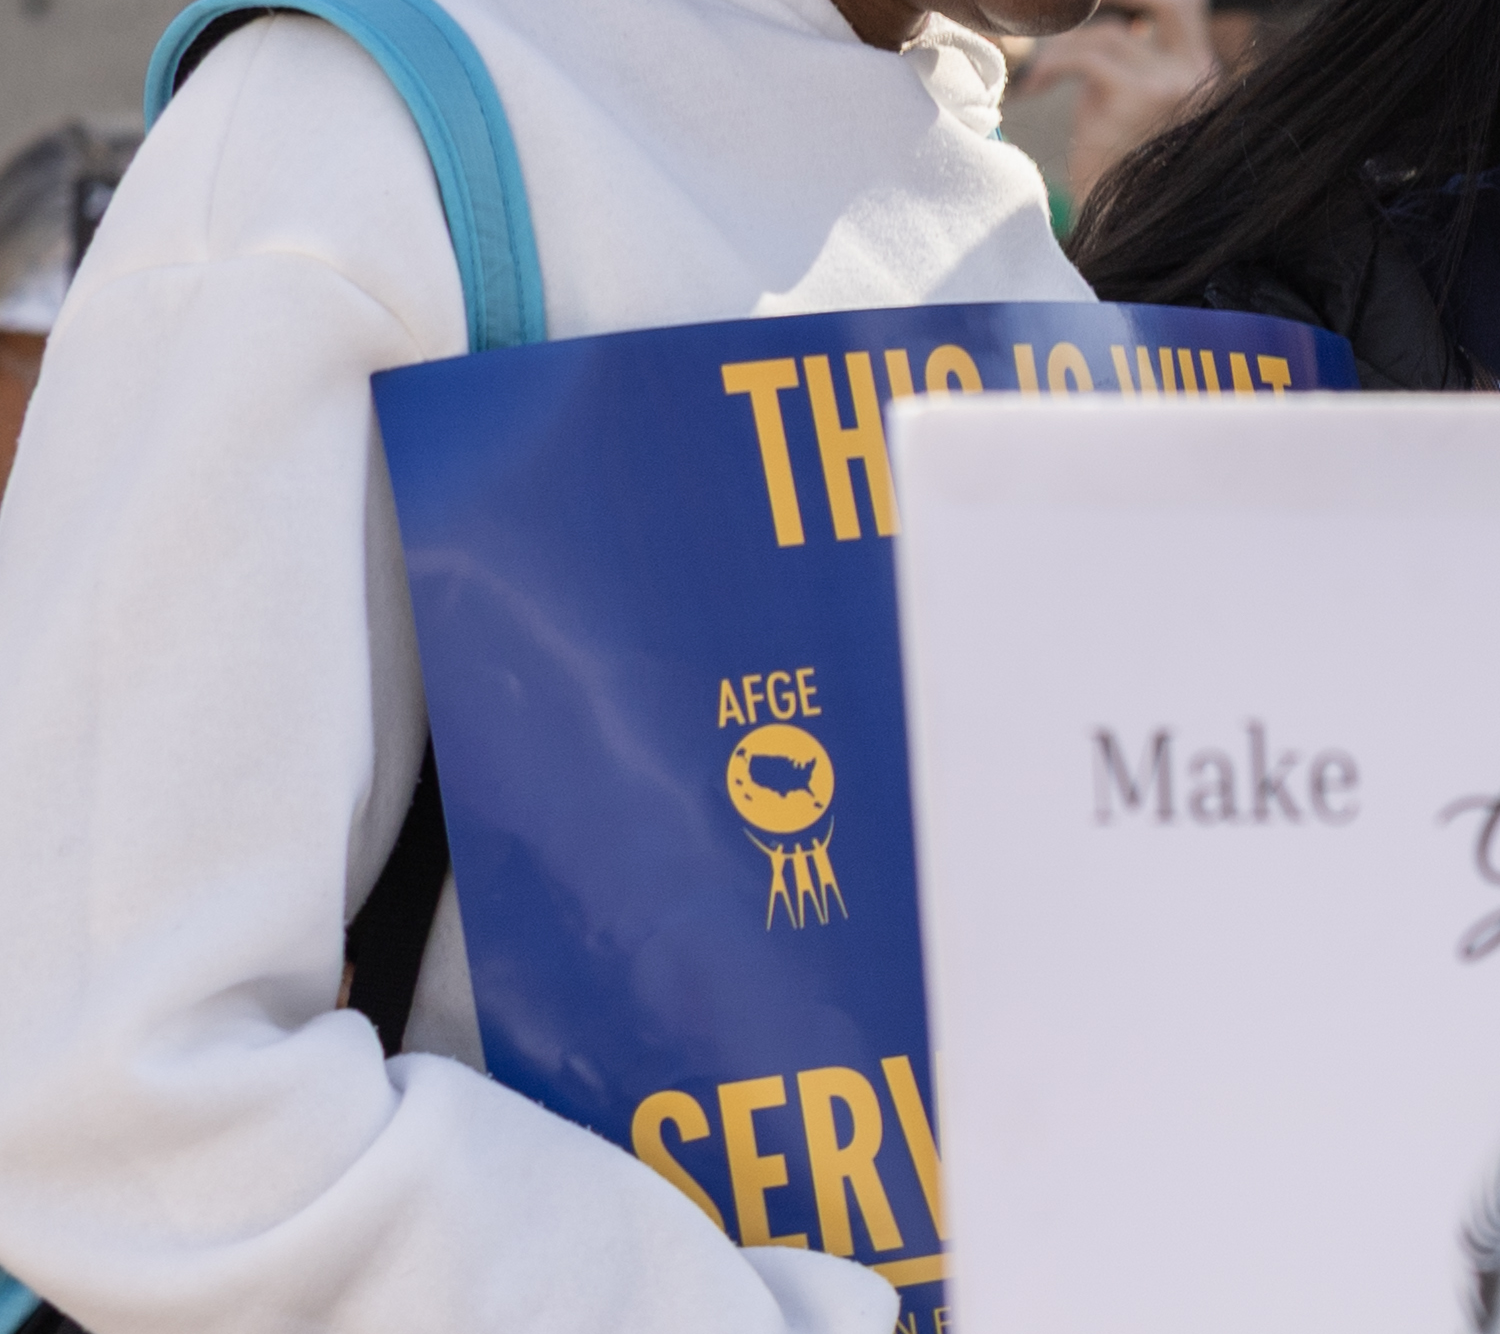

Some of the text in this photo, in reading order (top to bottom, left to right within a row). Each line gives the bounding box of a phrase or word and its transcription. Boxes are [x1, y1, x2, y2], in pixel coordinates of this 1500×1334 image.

[720, 344, 984, 548] TH
[717, 667, 821, 728] AFGE
[1088, 716, 1362, 828] Make
